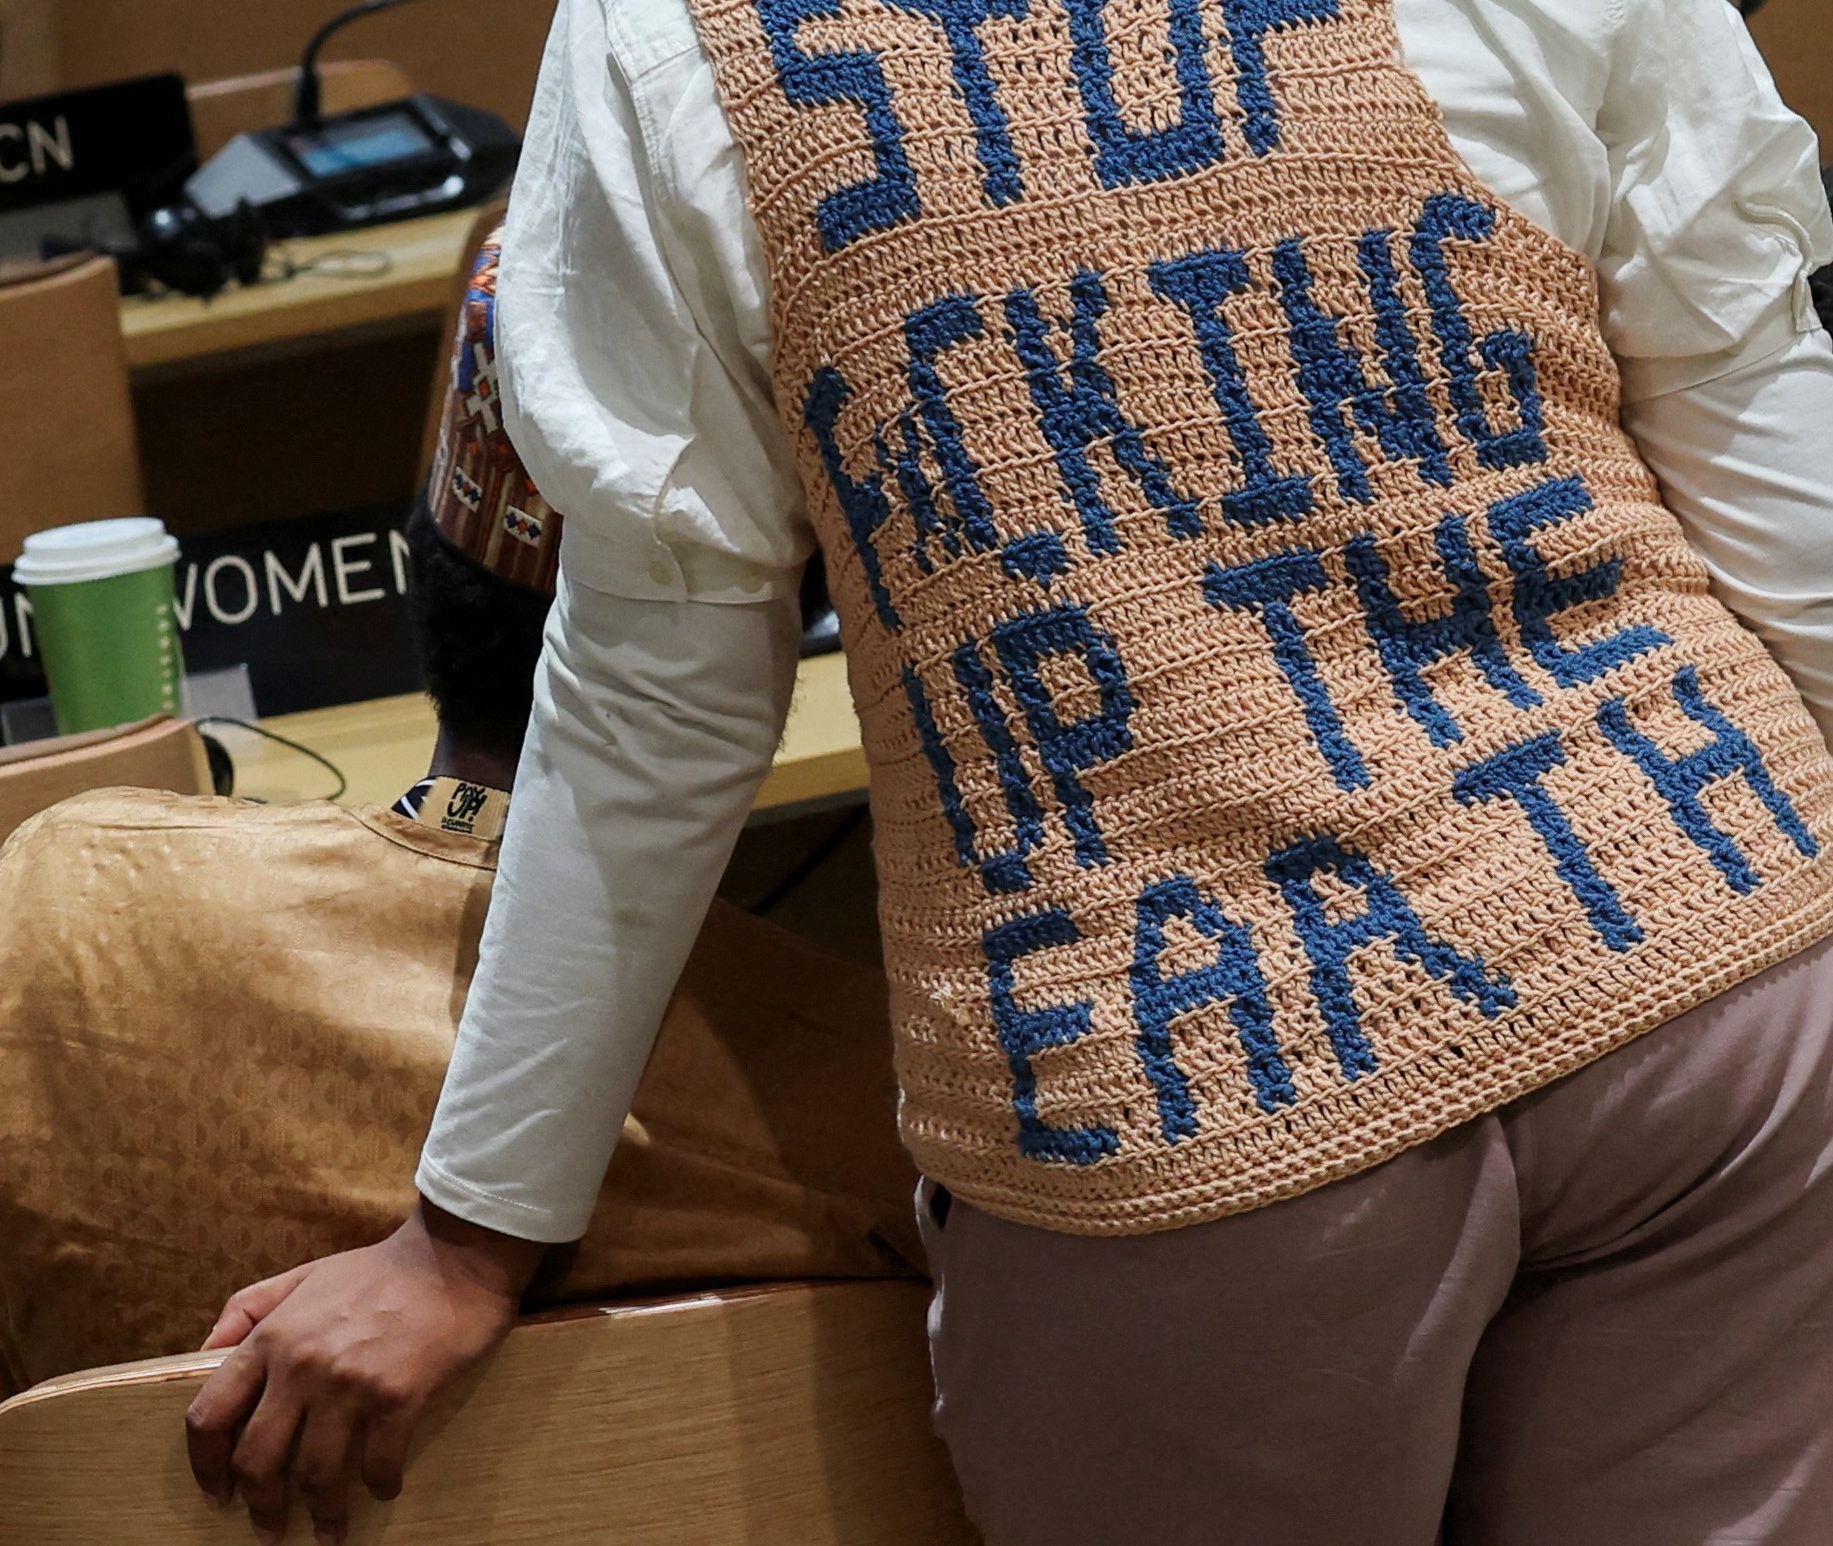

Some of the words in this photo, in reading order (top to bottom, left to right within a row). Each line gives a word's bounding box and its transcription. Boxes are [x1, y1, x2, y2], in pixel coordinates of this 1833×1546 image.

[452, 782, 486, 802] PAY
[901, 602, 1133, 896] UP
[1203, 474, 1672, 793] THE
[982, 664, 1818, 1167] EARTH
